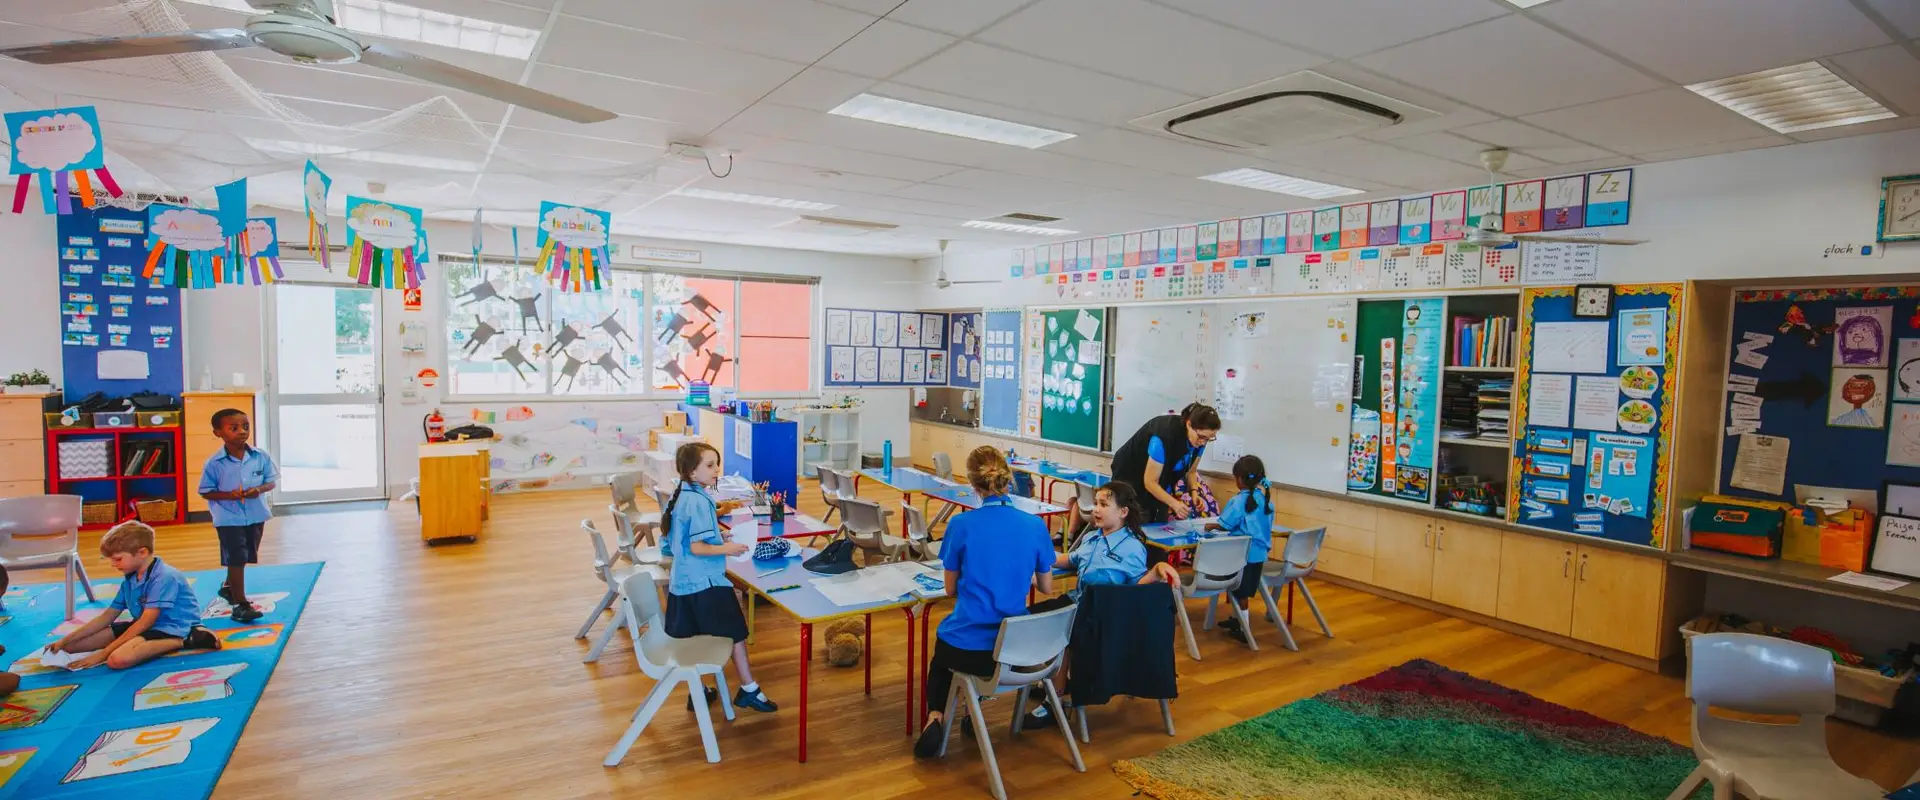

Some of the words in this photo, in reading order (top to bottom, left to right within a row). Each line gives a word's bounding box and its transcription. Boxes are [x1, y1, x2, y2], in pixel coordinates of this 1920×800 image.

[1556, 180, 1574, 205] Yy
[1596, 174, 1620, 194] Zz
[1513, 184, 1534, 203] Xx
[1377, 203, 1391, 219] Tt
[1407, 200, 1425, 217] Uu
[1440, 194, 1457, 212] Vv
[552, 216, 597, 232] Isabella
[1292, 213, 1306, 232] Qq
[1320, 212, 1334, 225] Rr
[1824, 243, 1853, 254] clock
[135, 726, 183, 744] D
